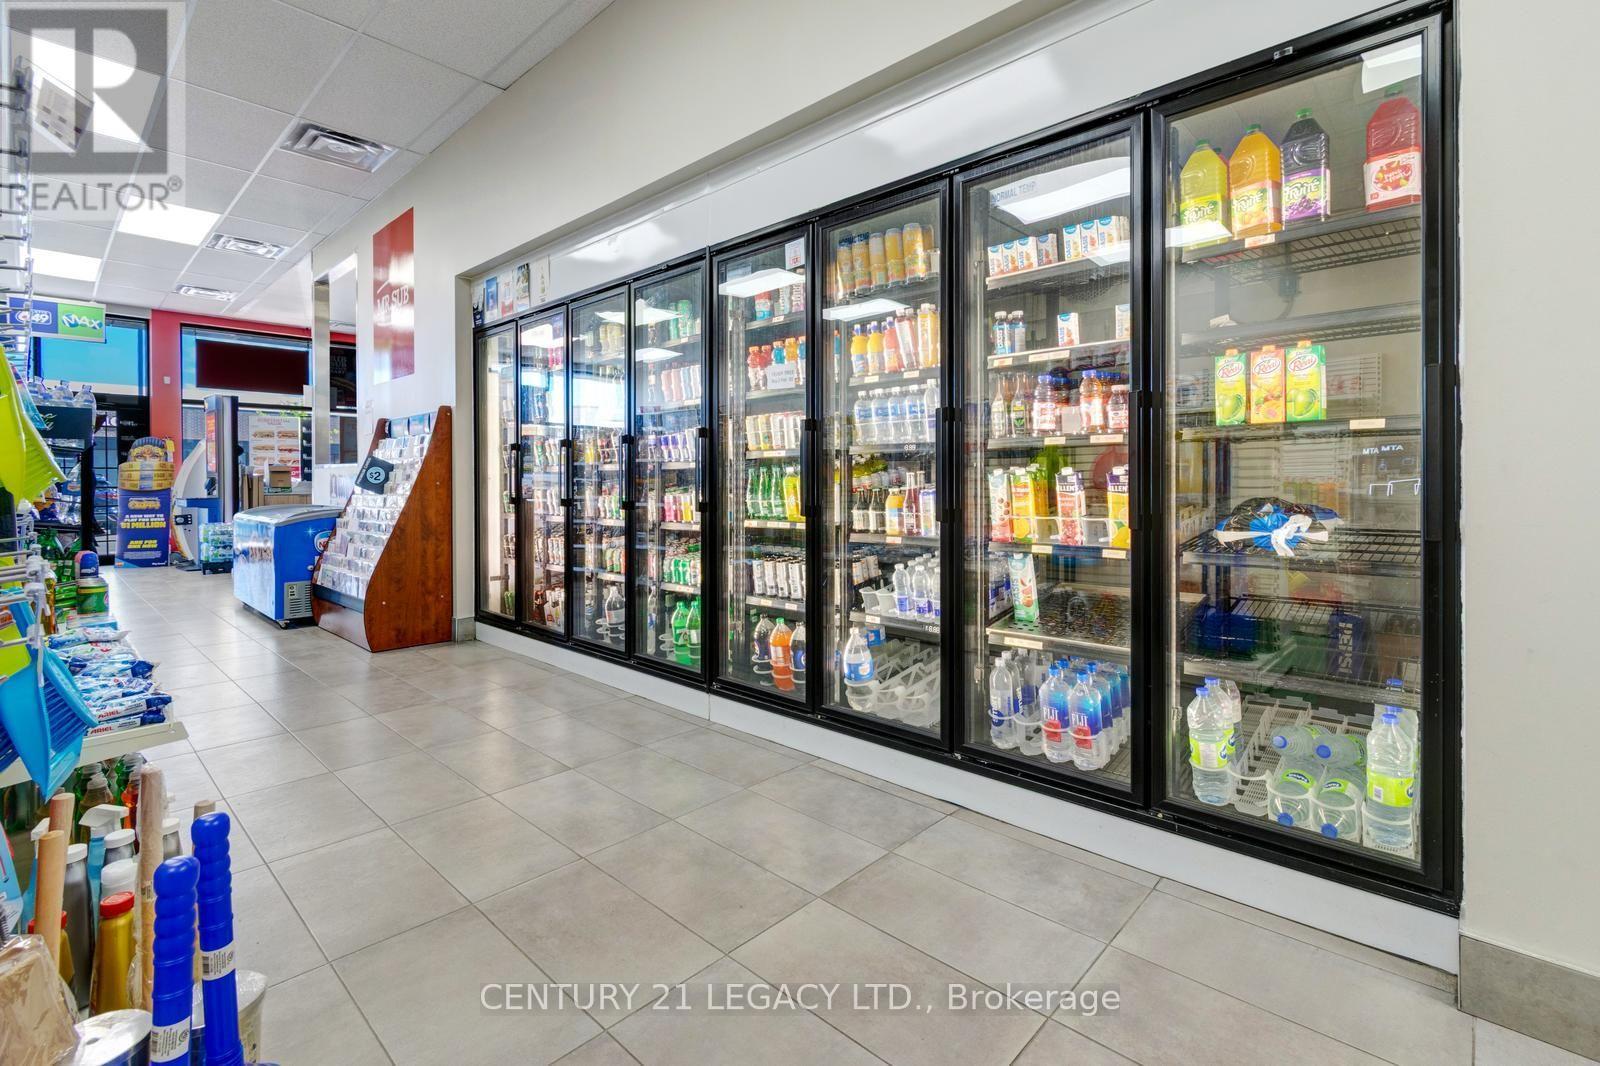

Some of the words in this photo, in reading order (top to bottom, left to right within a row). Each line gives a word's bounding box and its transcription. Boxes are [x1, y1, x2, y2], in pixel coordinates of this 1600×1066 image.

[369, 471, 381, 481] $2
[1338, 622, 1353, 673] PEPSI
[1043, 706, 1058, 720] FIJI
[1072, 712, 1088, 727] FIJI
